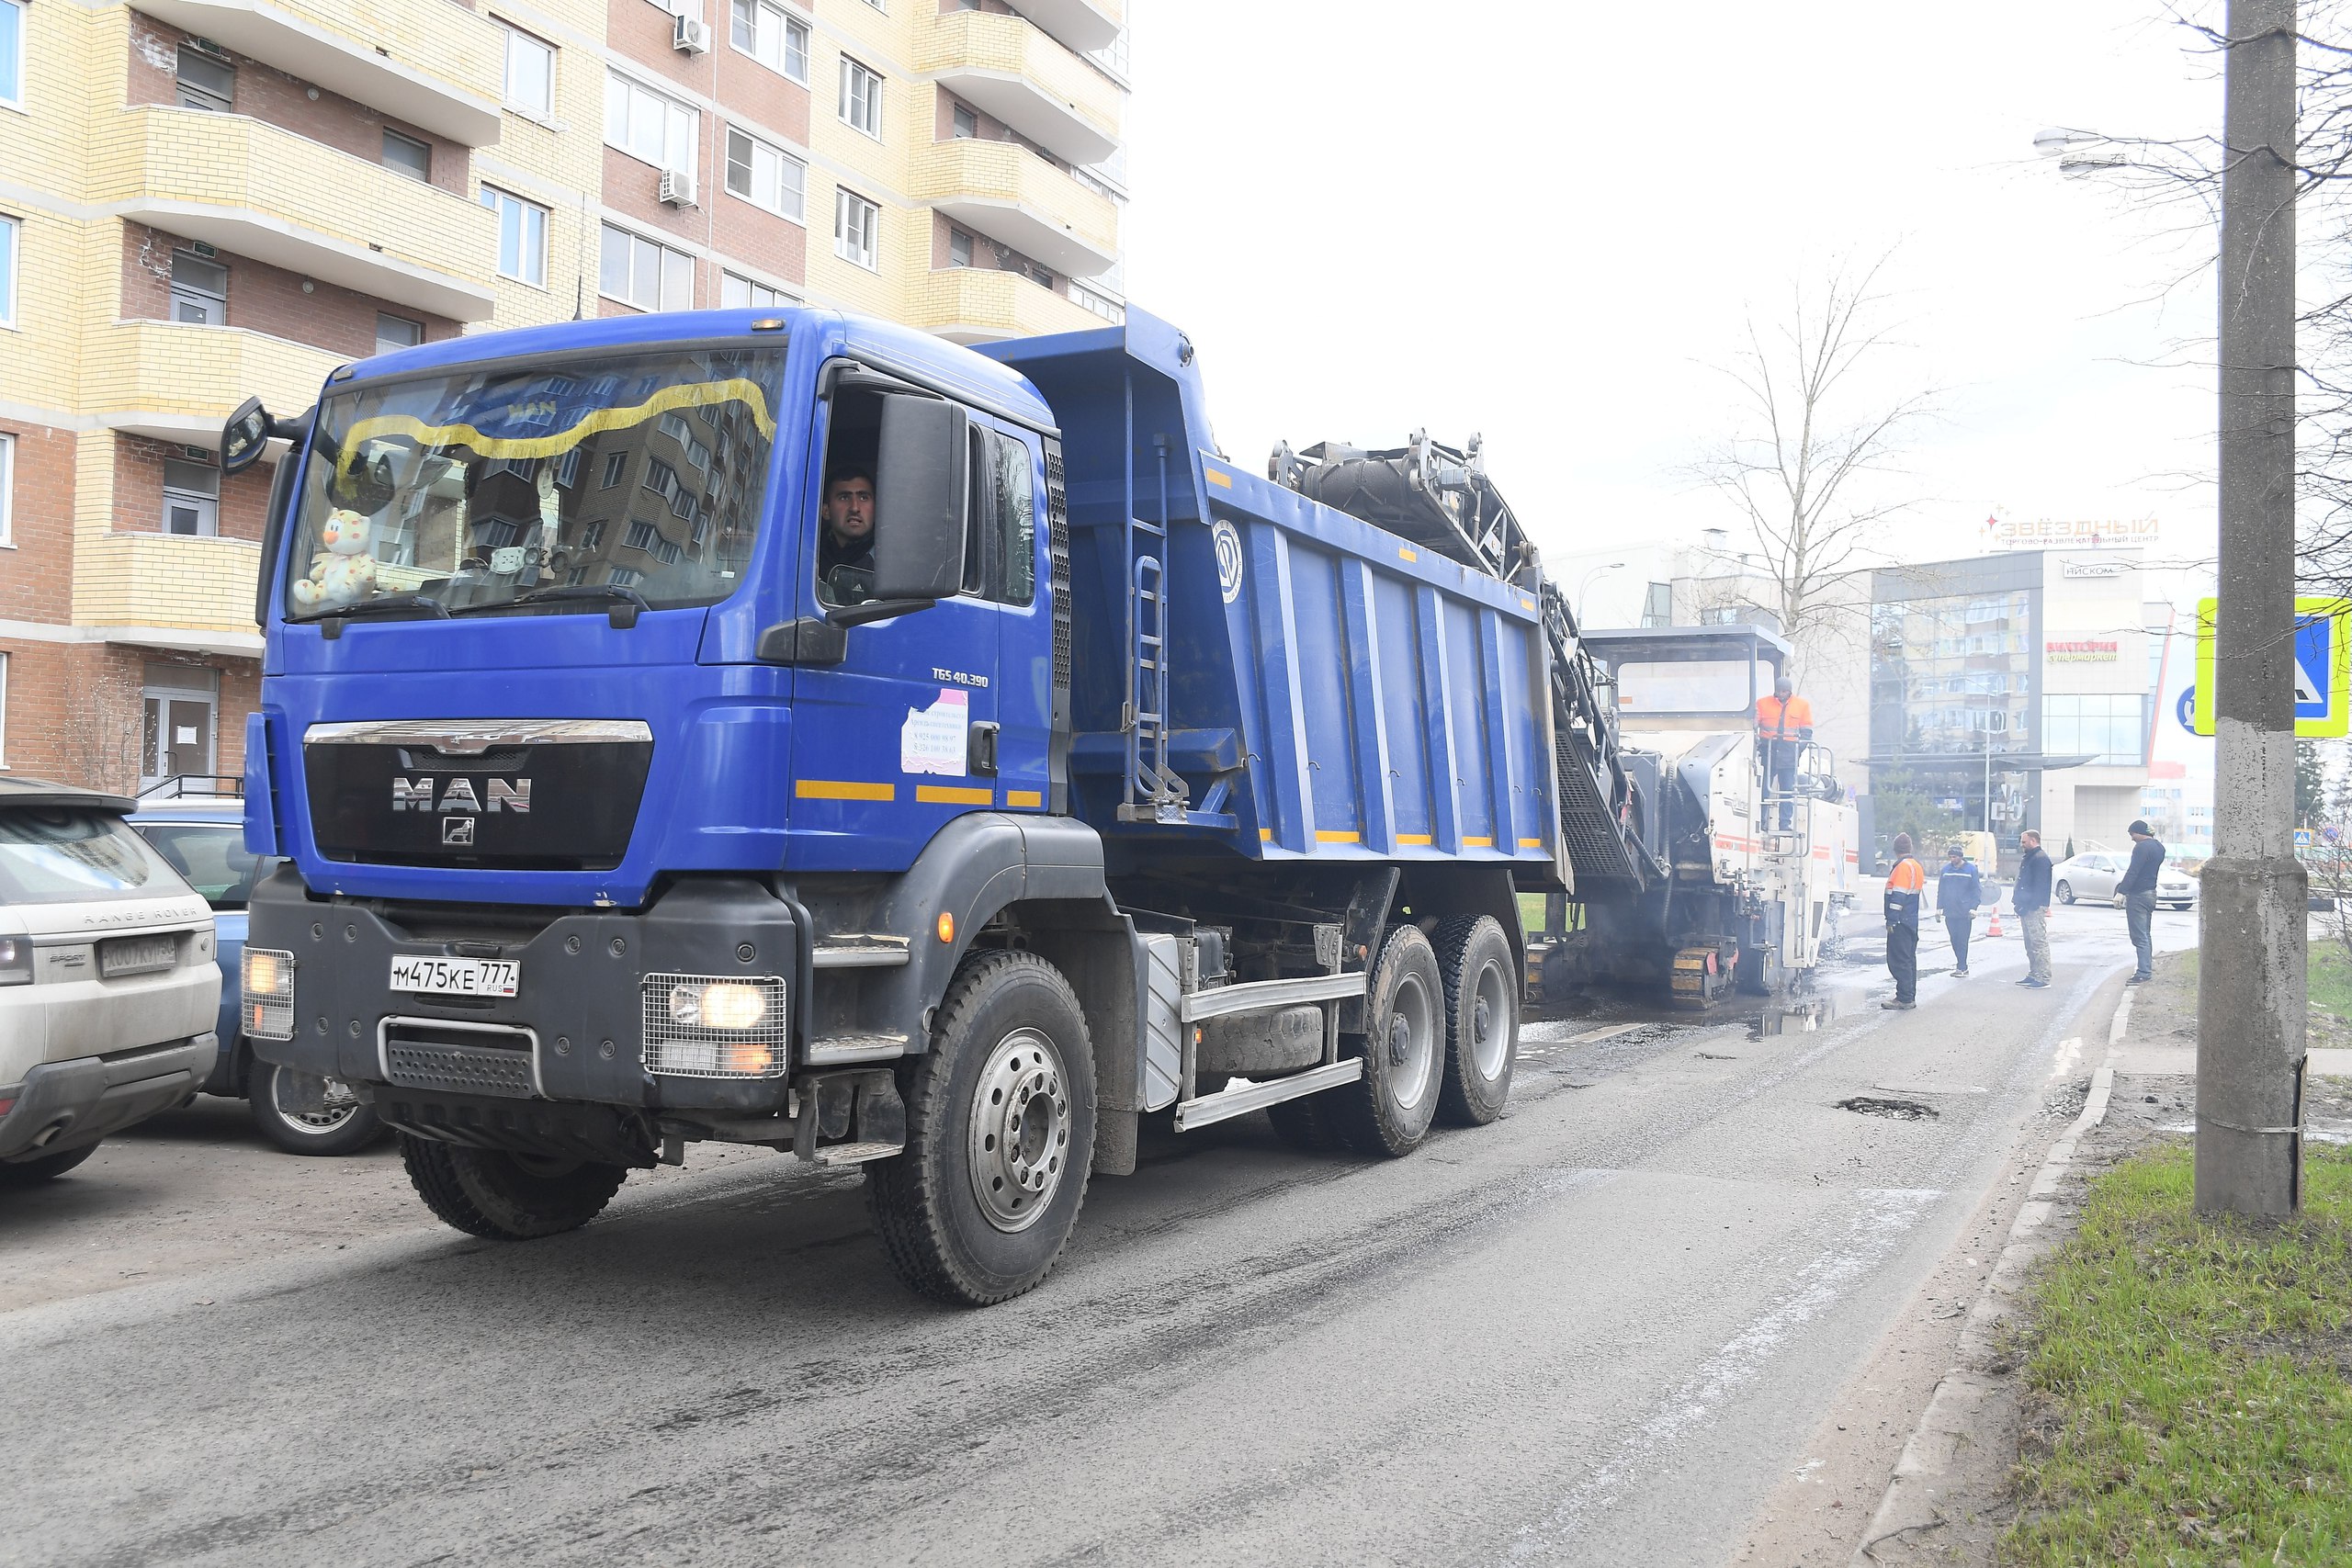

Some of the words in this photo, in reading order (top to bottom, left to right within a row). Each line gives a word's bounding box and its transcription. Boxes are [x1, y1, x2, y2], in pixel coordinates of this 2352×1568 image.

[507, 400, 557, 419] MAN
[2000, 511, 2159, 536] ЗВЁЗДНЫЙ
[2132, 536, 2159, 544] ЦЕНТР
[932, 667, 952, 682] TGS
[953, 671, 989, 688] 40.390
[392, 777, 532, 813] MAN
[85, 910, 146, 924] RANGE
[154, 908, 198, 919] ROVER
[50, 953, 86, 963] SPORT
[481, 963, 512, 985] 777
[487, 984, 503, 993] RUS
